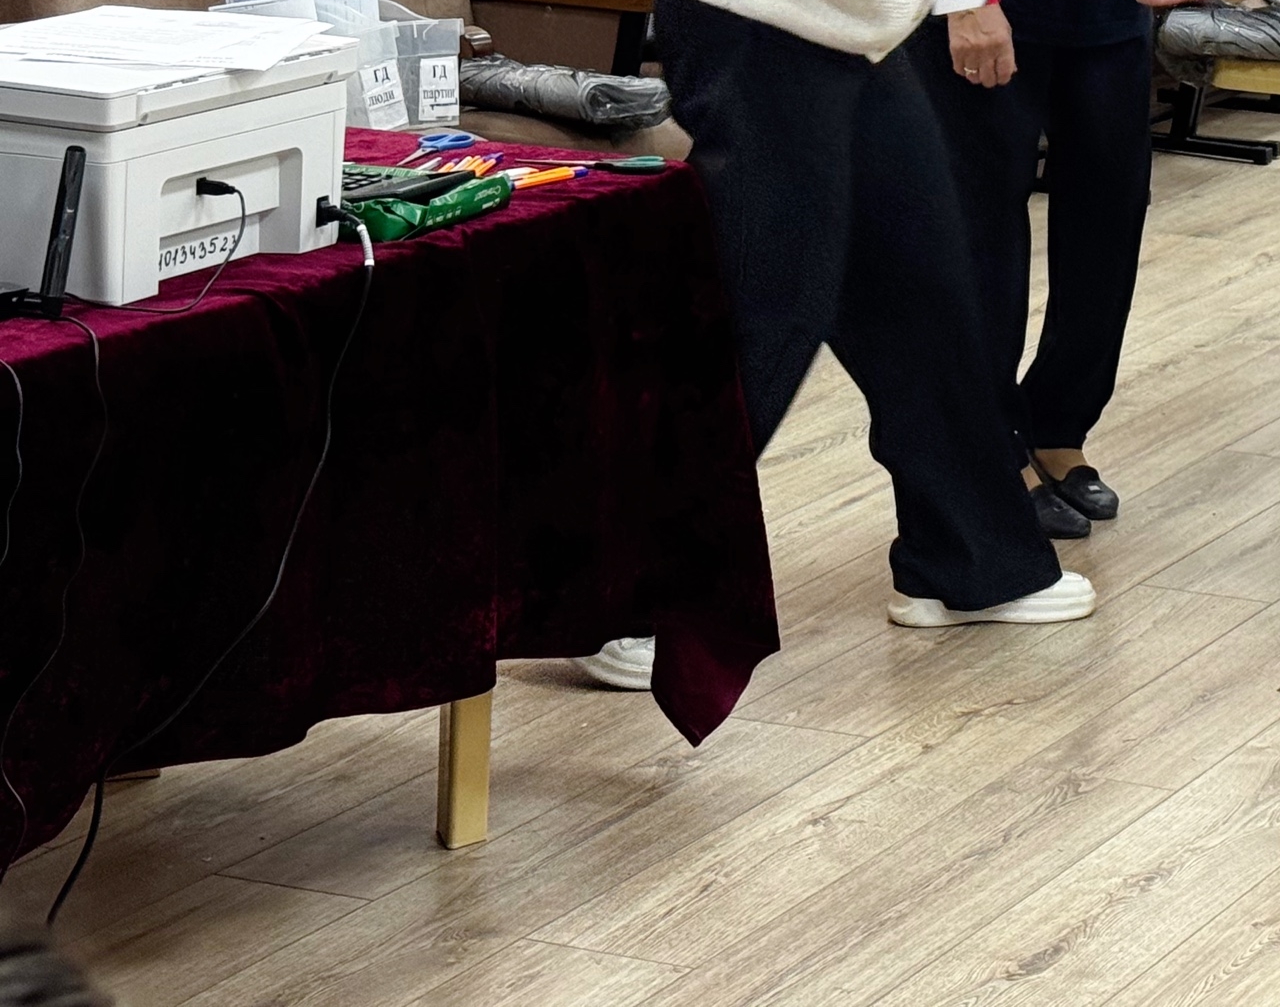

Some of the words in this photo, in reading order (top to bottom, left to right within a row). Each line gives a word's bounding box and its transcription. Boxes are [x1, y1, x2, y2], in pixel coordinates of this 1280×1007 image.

[373, 66, 391, 84] ГД
[432, 64, 448, 81] ГД
[368, 89, 396, 107] люди
